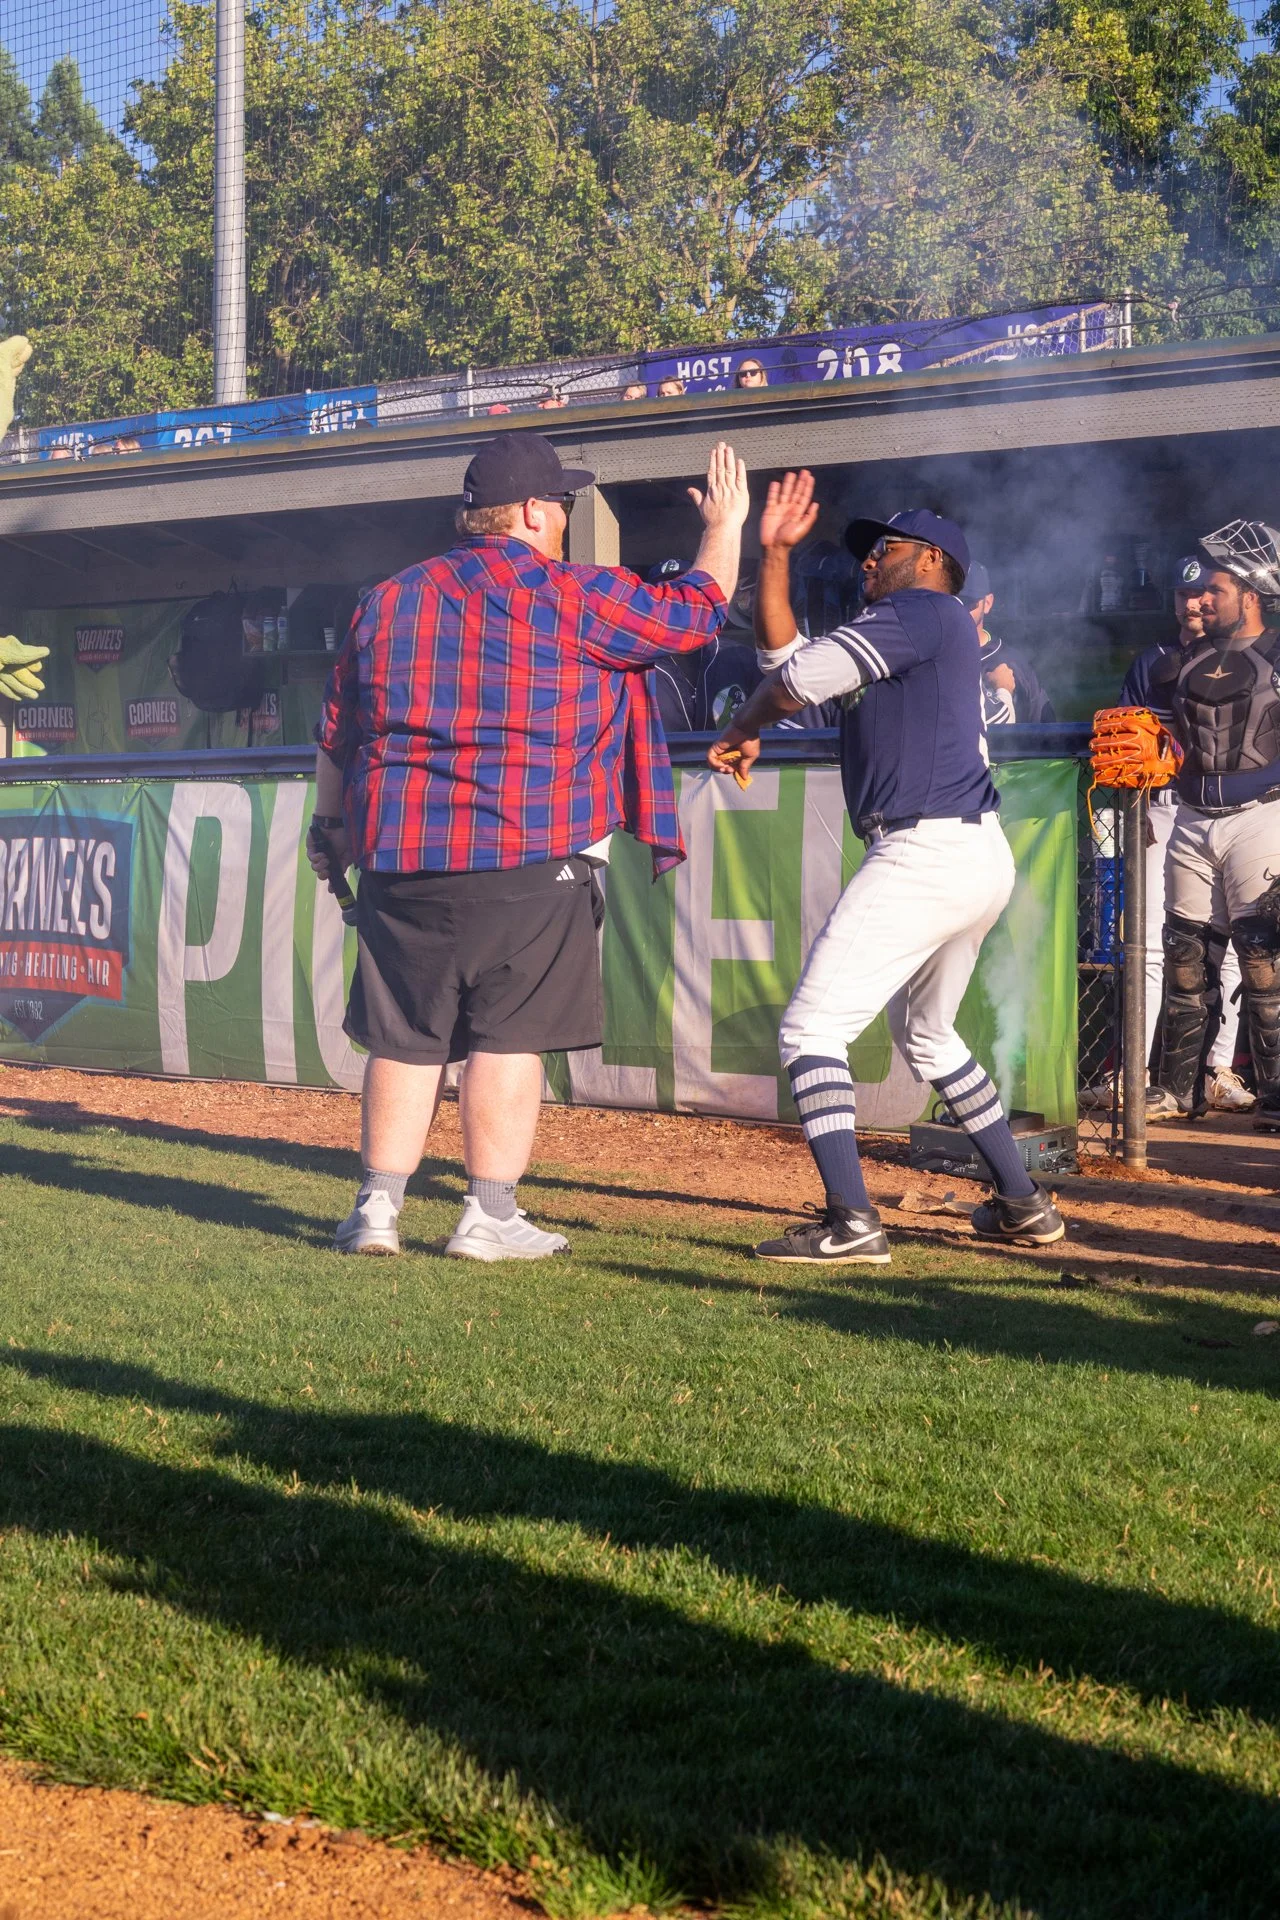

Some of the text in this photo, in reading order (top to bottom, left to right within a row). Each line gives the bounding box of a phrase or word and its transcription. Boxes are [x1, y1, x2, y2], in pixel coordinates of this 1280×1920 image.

[677, 356, 732, 383] HOST
[817, 343, 903, 381] 208
[18, 706, 74, 729] CORNEL'S
[128, 701, 177, 726] CORNEL'S
[0, 837, 116, 940] RNEL'S
[24, 952, 77, 981] HEATING
[87, 958, 110, 987] AIR
